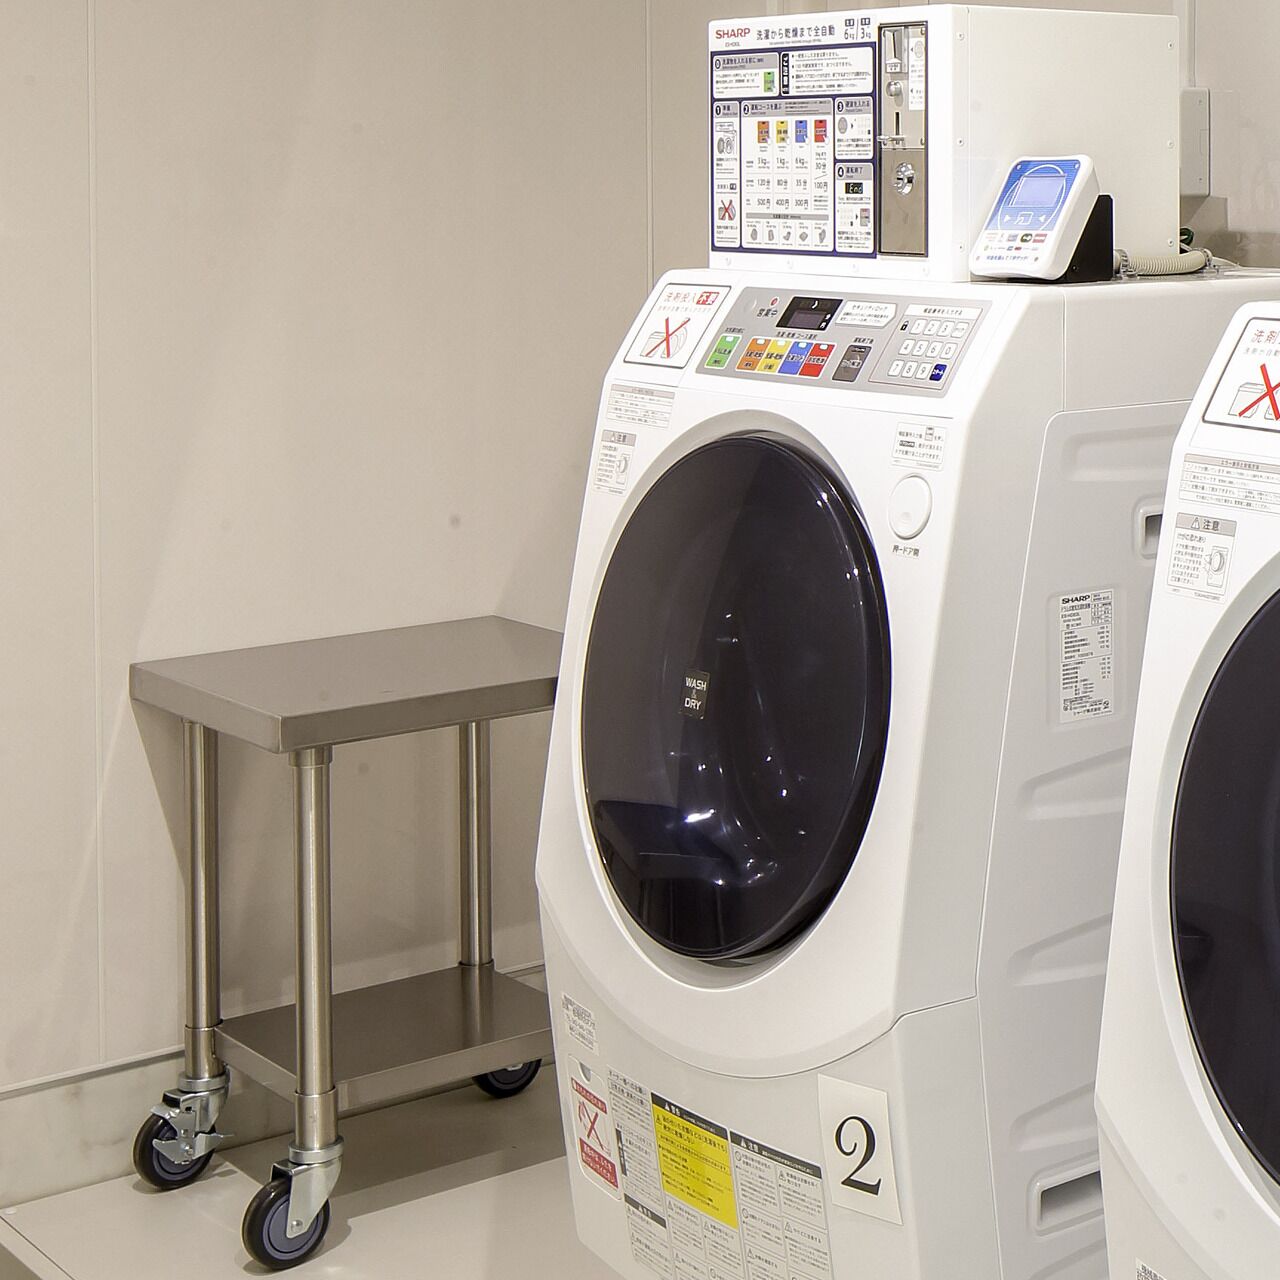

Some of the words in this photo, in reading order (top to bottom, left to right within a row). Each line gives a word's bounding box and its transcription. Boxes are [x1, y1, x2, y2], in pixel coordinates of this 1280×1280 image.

[715, 28, 751, 40] SHARP
[1061, 594, 1091, 604] SHARP
[685, 676, 707, 691] WASH
[684, 697, 702, 710] DRY
[834, 1115, 882, 1196] 2
